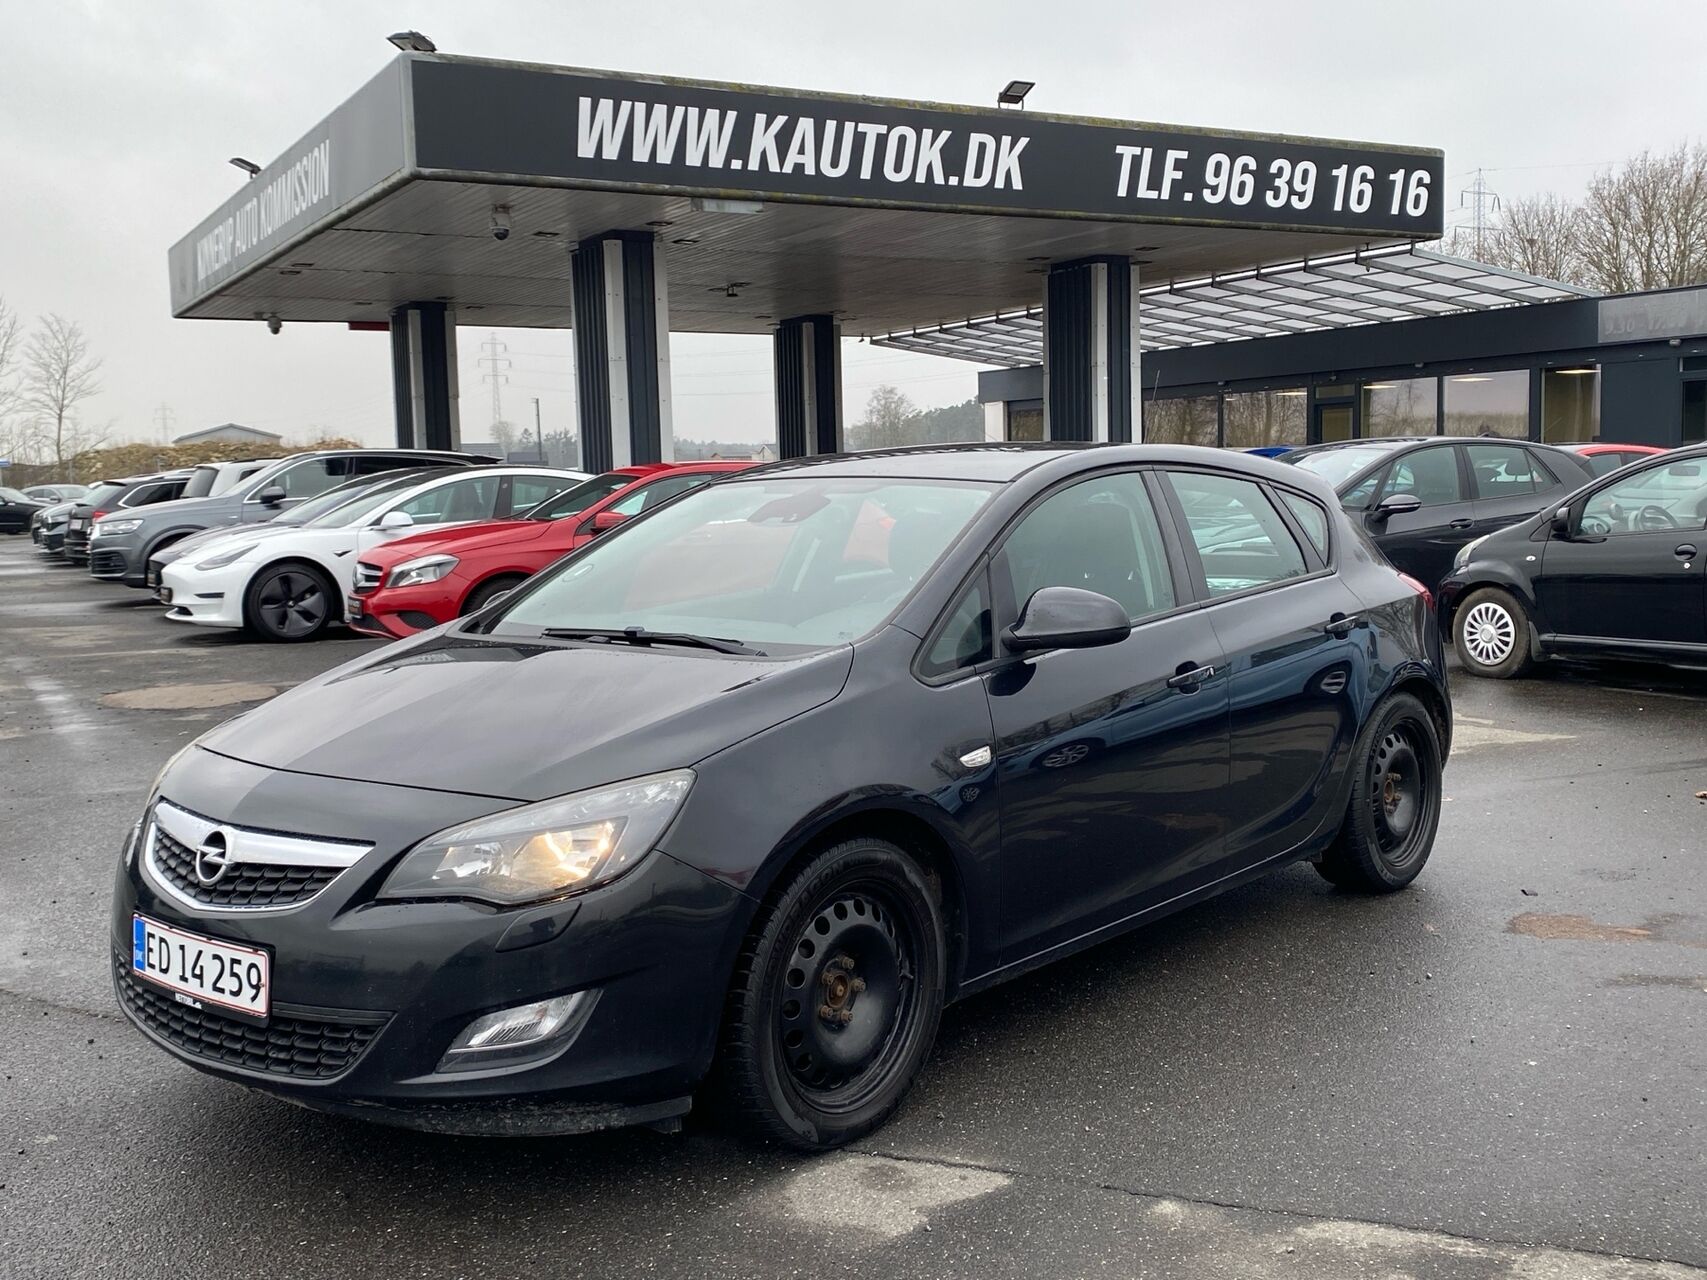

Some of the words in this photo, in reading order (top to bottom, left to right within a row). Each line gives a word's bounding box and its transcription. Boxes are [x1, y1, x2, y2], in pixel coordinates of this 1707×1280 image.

[577, 97, 1030, 190] WWW.KAUTOK.DK
[1115, 145, 1192, 201] TLF.
[1202, 153, 1257, 205] 96
[1265, 158, 1317, 210] 39
[1332, 164, 1375, 214] 16
[1389, 168, 1431, 217] 16
[235, 197, 258, 257] AUTO
[260, 139, 330, 241] KOMMISSION
[146, 932, 171, 975] ED
[179, 944, 204, 988] 14
[212, 954, 262, 1003] 259
